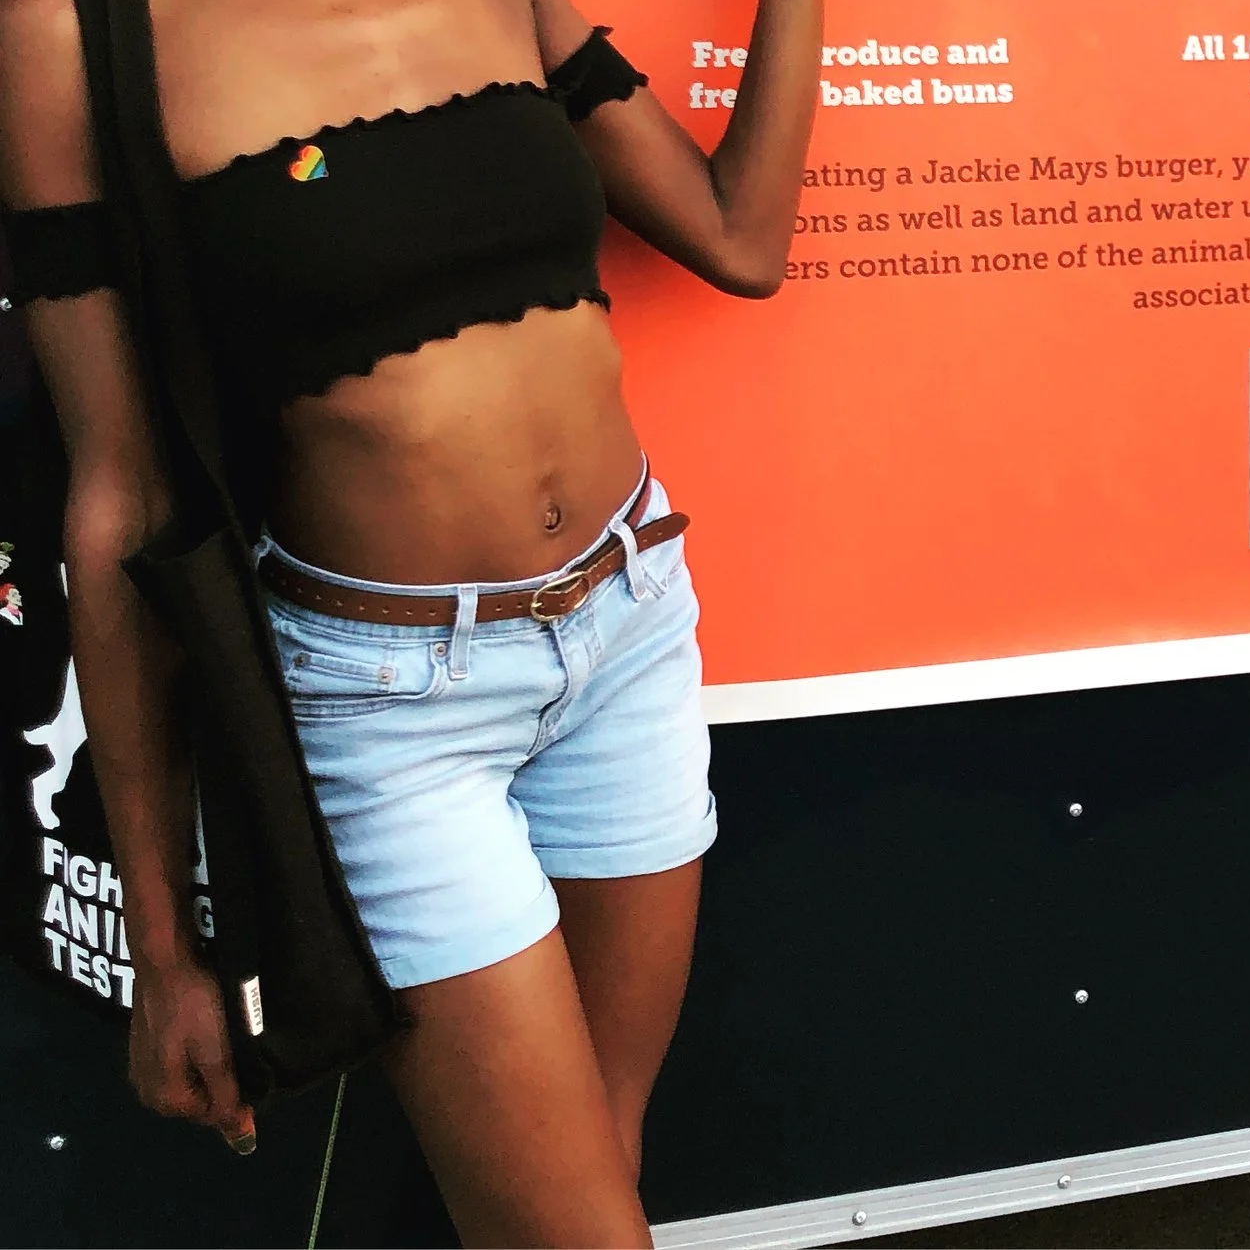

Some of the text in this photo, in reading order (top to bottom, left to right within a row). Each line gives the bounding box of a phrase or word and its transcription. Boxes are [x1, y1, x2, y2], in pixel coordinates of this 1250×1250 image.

[692, 37, 1010, 68] Fre roduce and
[1181, 34, 1226, 61] All
[819, 78, 1014, 107] baked buns
[802, 161, 887, 193] ating
[895, 166, 914, 186] a
[921, 157, 1021, 185] Jackie
[1029, 155, 1108, 186] Mays
[1114, 153, 1223, 183] burger,
[856, 212, 890, 232] as
[897, 203, 964, 231] well
[971, 208, 1003, 228] as
[1009, 199, 1079, 227] land
[1086, 197, 1143, 224] and
[1150, 197, 1234, 221] water
[839, 249, 963, 279] contain
[970, 251, 1049, 273] none
[1057, 242, 1088, 269] of
[1095, 242, 1144, 267] the
[44, 926, 136, 1009] TEST
